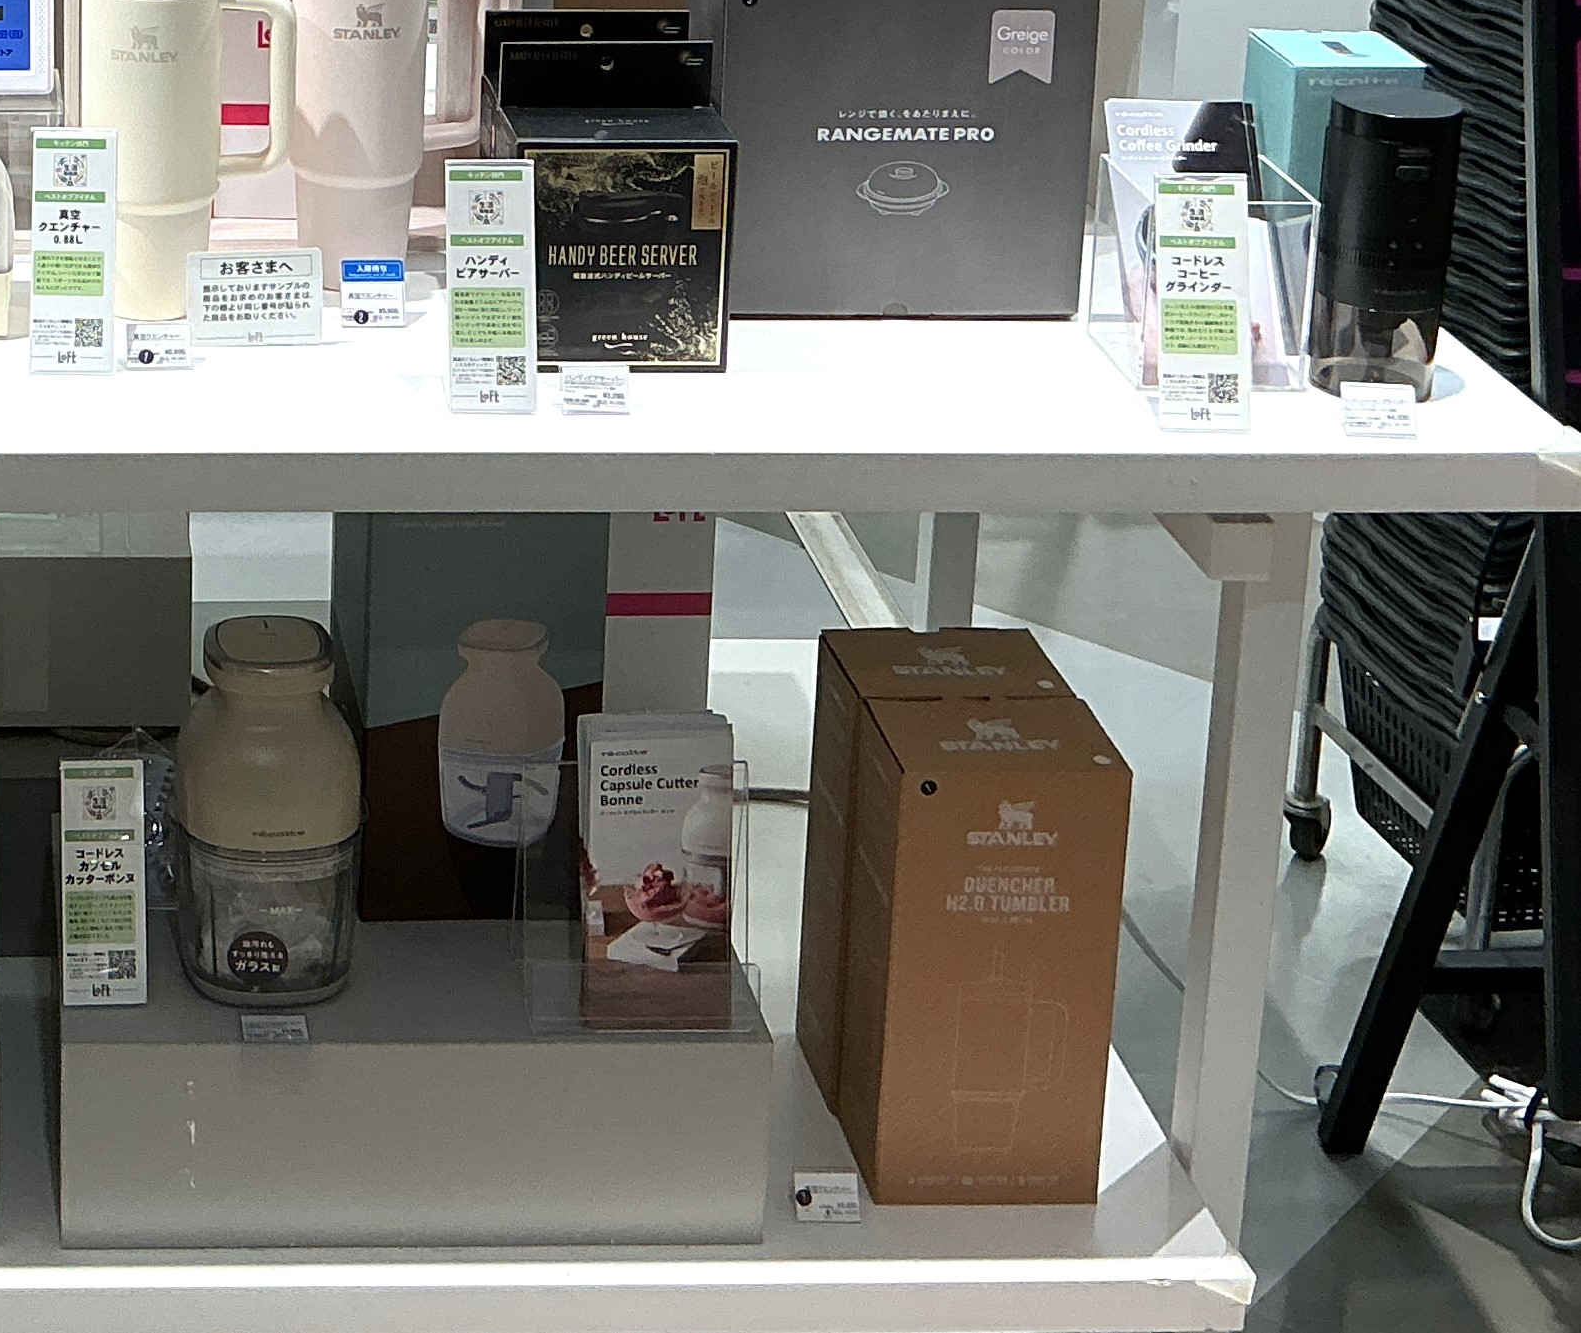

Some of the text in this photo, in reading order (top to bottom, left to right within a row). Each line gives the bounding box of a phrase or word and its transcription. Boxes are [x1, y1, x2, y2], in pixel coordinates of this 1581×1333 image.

[333, 27, 401, 41] STANLEY
[996, 25, 1050, 45] Greige
[110, 49, 178, 64] STANLEY
[1001, 46, 1042, 56] COLOR
[816, 126, 997, 143] RANGEMATE PRO
[1116, 123, 1175, 137] Cordless
[1118, 138, 1219, 153] Coffee Grinder
[58, 209, 81, 220] 真空
[38, 221, 101, 233] クエンチャー
[53, 234, 84, 245] 0.88L
[464, 254, 508, 267] ハンディ
[547, 244, 698, 266] HANDY BEER SERVER
[1171, 255, 1225, 267] コードレス
[219, 260, 294, 276] お客さまへ
[455, 266, 520, 279] ビアサーバー
[1176, 269, 1220, 279] コーヒー
[202, 281, 311, 294] 展示しておりますサンプルの
[1164, 280, 1233, 293] グラインダー
[591, 332, 649, 343] green house
[57, 350, 77, 364] Loft
[479, 389, 500, 404] Loft
[1189, 406, 1212, 422] Loft
[891, 664, 1007, 676] STANLEY
[939, 739, 1059, 751] STANLEY
[600, 763, 659, 777] Cordless
[600, 776, 700, 792] Capsule Cutter
[600, 793, 644, 807] Bonne
[966, 831, 1059, 846] STANLEY
[74, 848, 125, 860] コードレス
[64, 873, 136, 886] カッターボンヌ
[964, 876, 1057, 895] QUENCHER
[945, 894, 1071, 913] H2.0 TUMBLER
[91, 983, 112, 998] Loft
